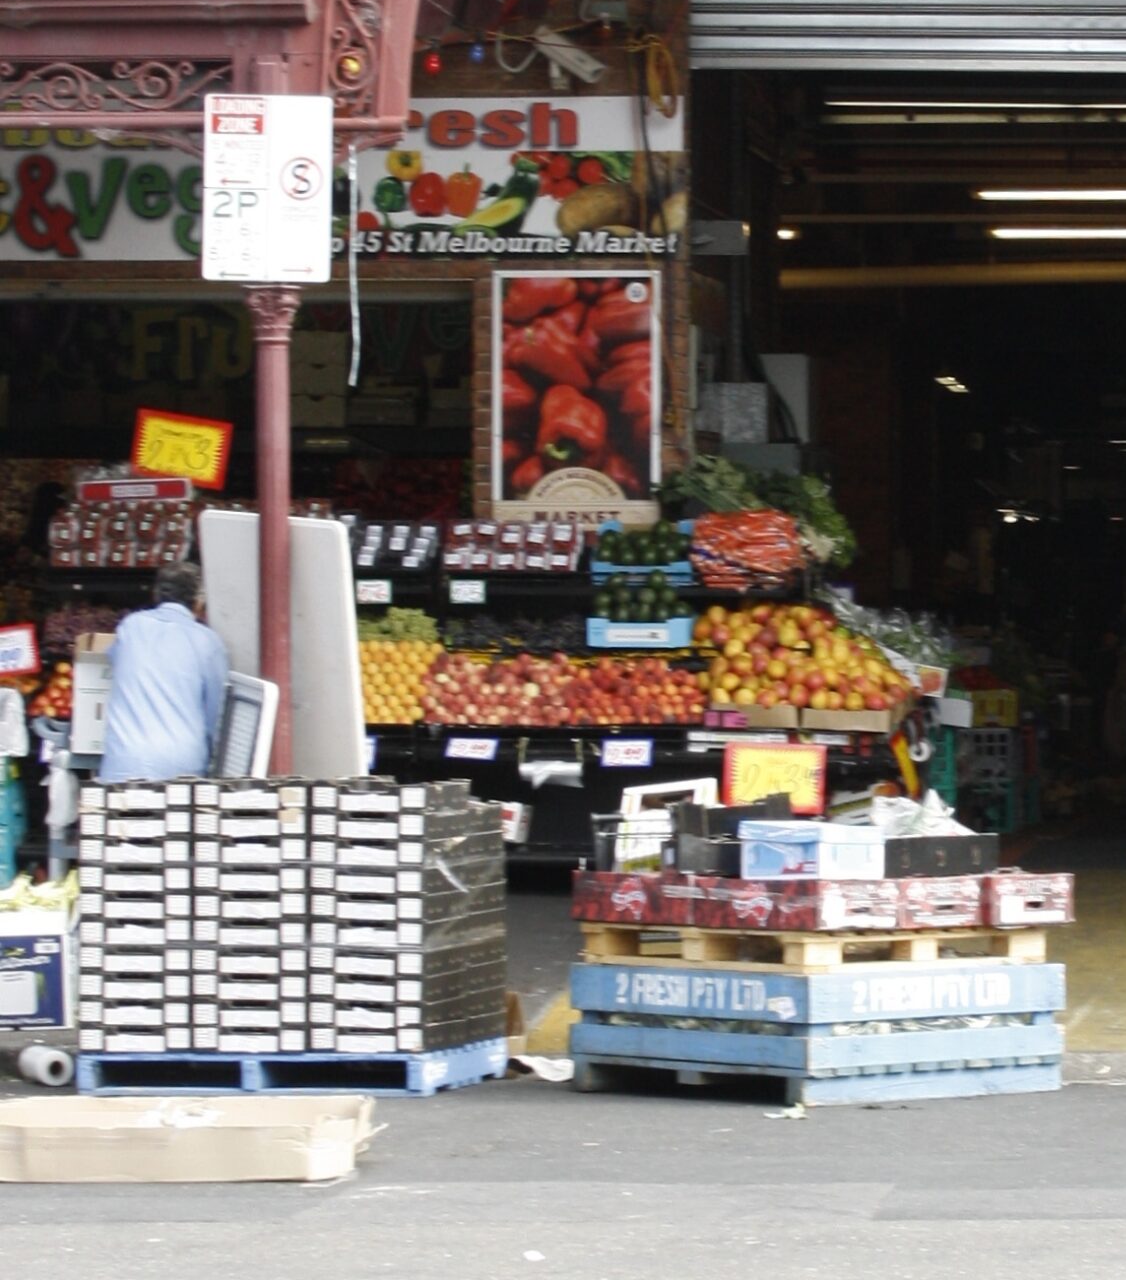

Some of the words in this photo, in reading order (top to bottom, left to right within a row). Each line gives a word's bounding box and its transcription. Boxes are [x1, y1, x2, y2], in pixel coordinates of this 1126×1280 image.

[212, 191, 259, 218] 2P
[417, 231, 571, 254] Melbourne
[574, 231, 678, 254] Market
[630, 973, 690, 1008] FRESH
